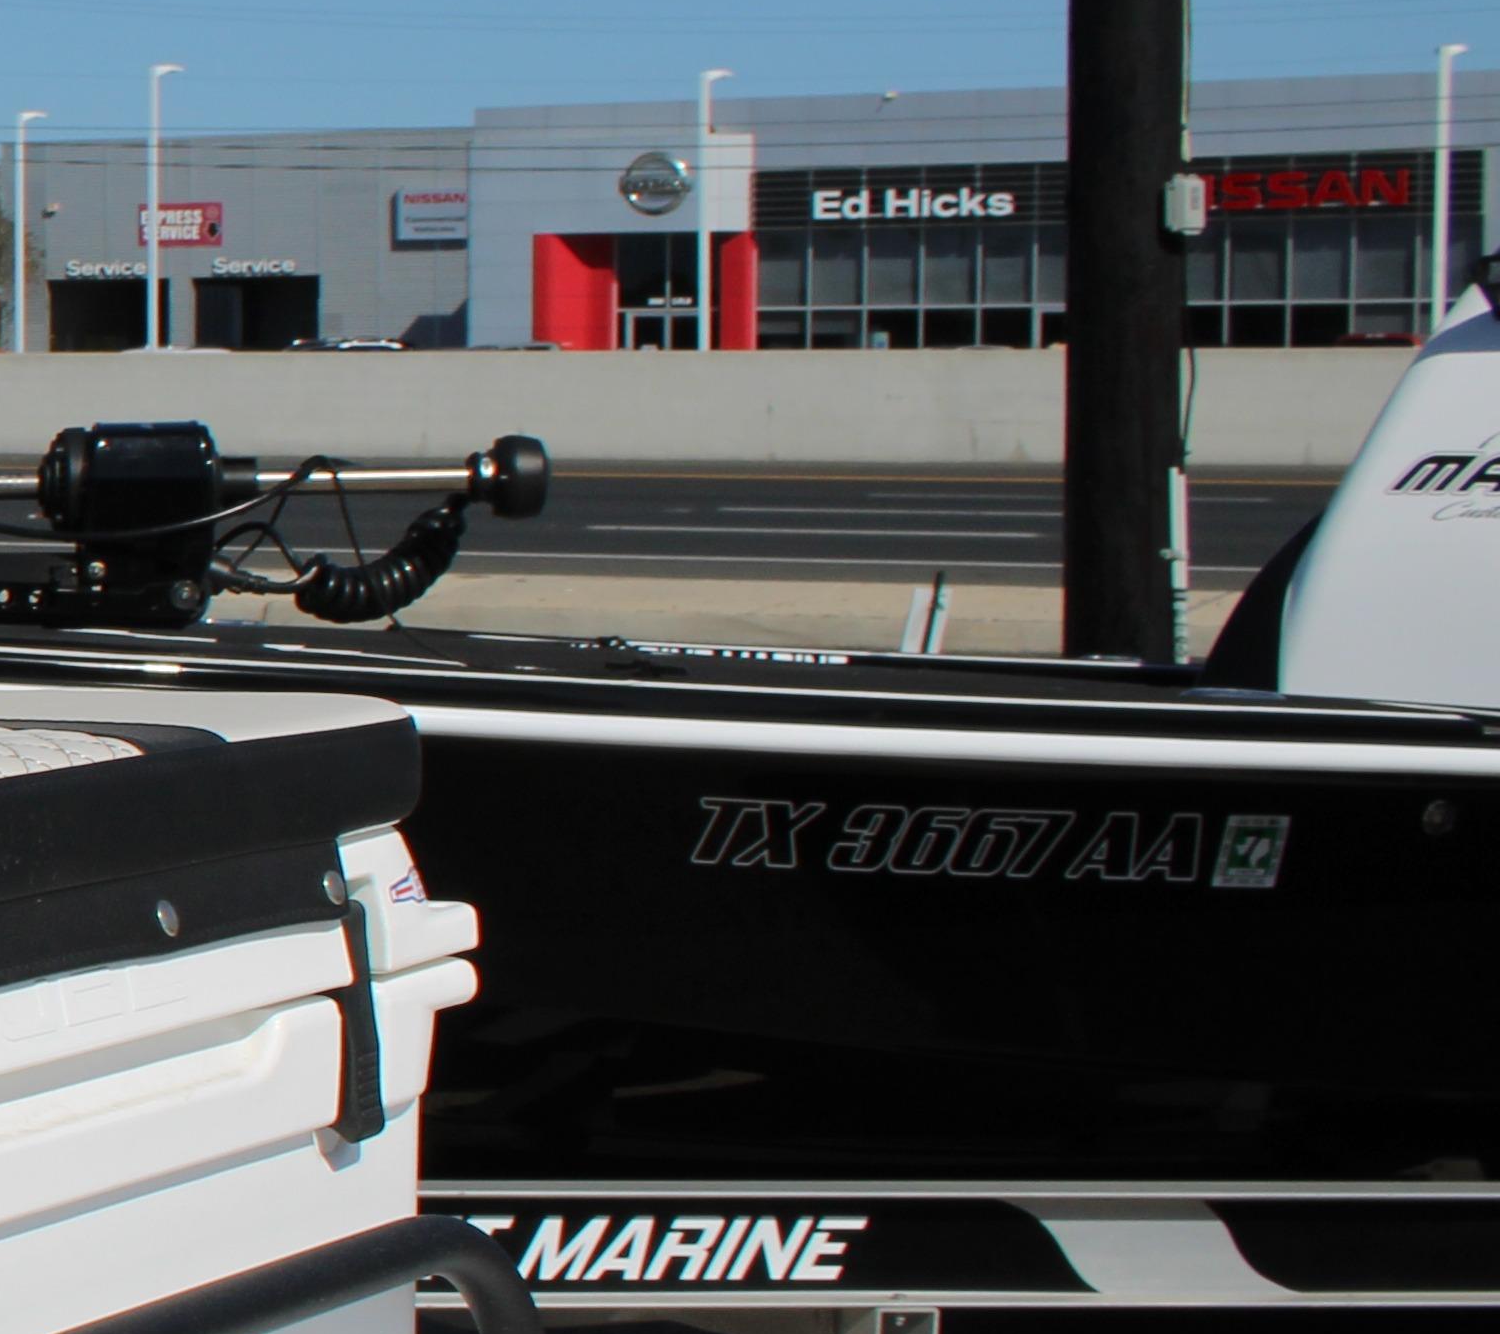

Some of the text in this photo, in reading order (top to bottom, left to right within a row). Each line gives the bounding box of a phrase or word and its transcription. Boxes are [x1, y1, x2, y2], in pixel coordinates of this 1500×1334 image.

[812, 186, 1016, 220] Ed Hicks
[1200, 169, 1409, 210] ISSAN
[140, 209, 203, 225] EPRESS
[66, 259, 147, 277] Service
[212, 257, 296, 276] Service
[692, 797, 826, 868] TX
[828, 805, 1076, 877] 3667
[1065, 812, 1203, 881] AA
[517, 1215, 868, 1281] MARINE
